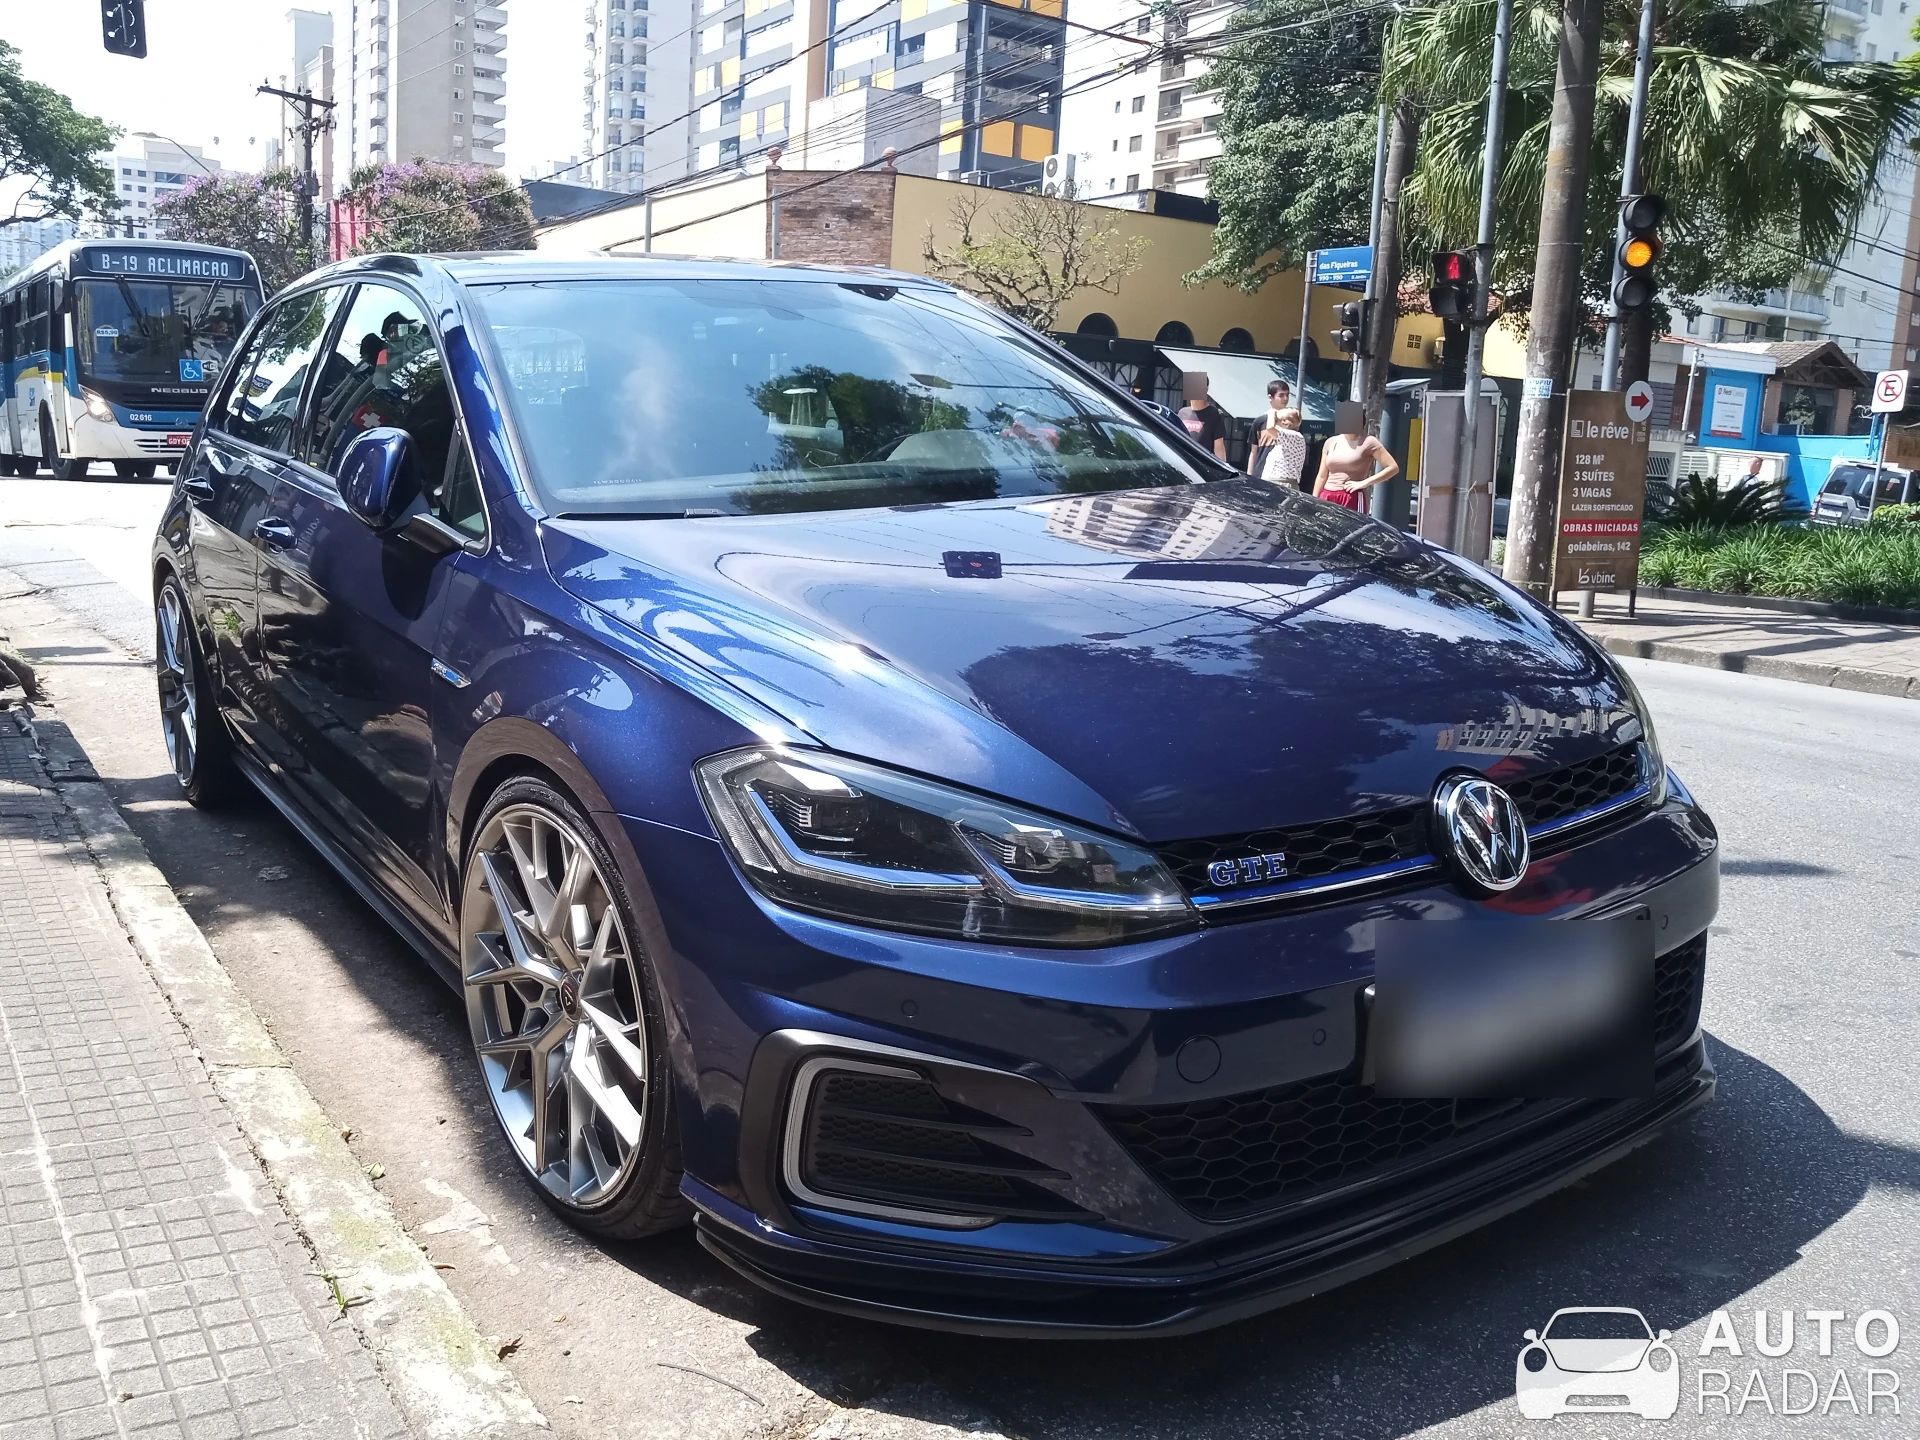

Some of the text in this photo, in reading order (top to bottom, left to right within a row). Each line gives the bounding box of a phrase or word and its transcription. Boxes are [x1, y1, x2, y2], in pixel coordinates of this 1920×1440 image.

[102, 253, 229, 277] B-19 ACLIMACAO
[1319, 262, 1330, 270] das
[1330, 260, 1359, 271] Figueiras
[1586, 420, 1599, 438] le
[1600, 421, 1629, 439] rêve
[1575, 454, 1591, 465] 128
[1573, 468, 1615, 482] 3 SUÍTES
[1572, 487, 1612, 498] 3 VAGAS
[1571, 503, 1634, 512] LAZER SOFISTICADO
[1563, 523, 1639, 532] OBRAS INICIADAS
[1567, 541, 1631, 554] goiabeiras, 142
[1591, 571, 1616, 584] vbinc
[1207, 852, 1288, 887] GTE
